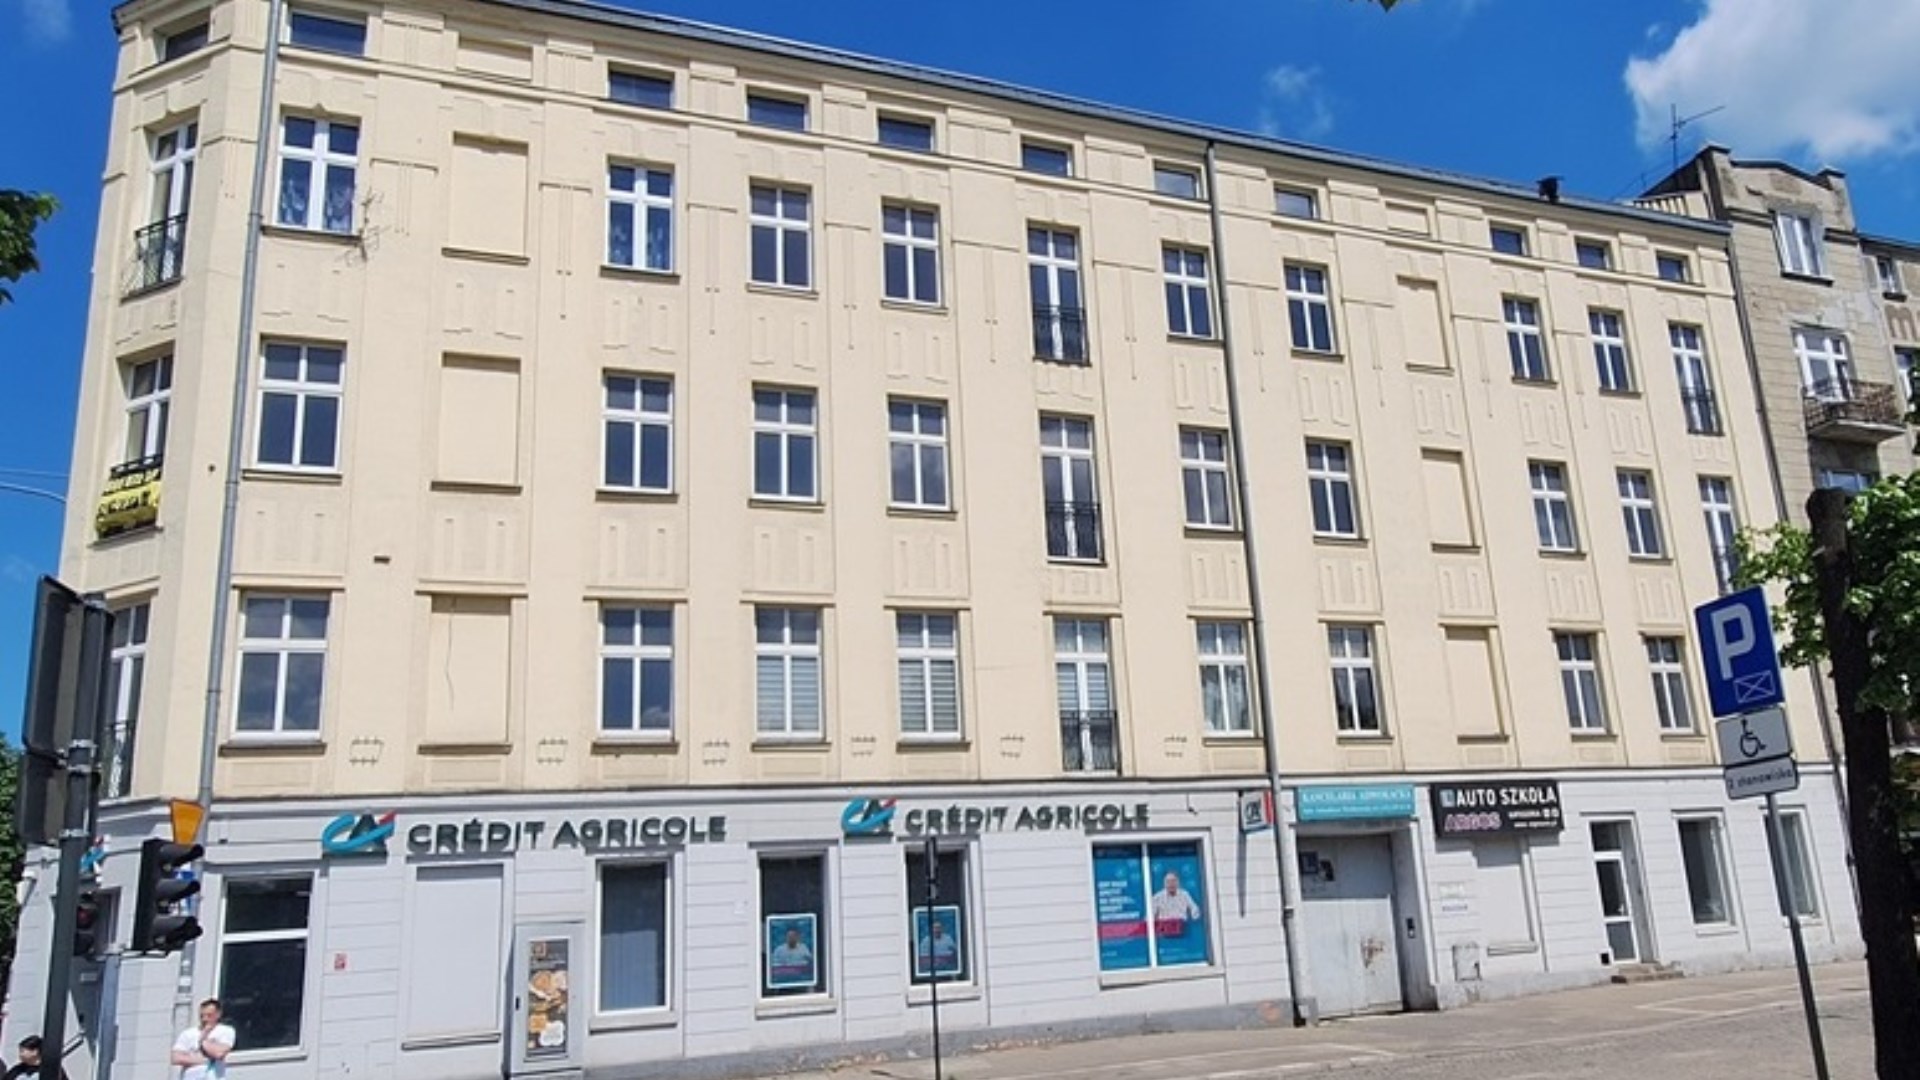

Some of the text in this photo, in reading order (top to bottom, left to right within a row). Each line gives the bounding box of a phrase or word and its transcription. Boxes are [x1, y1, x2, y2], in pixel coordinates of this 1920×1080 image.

[1709, 602, 1756, 680] P
[1457, 788, 1496, 808] AUTO
[407, 816, 727, 854] CRÉDIT AGRICOLE
[905, 804, 1149, 834] CRÉDIT AGRICOLE
